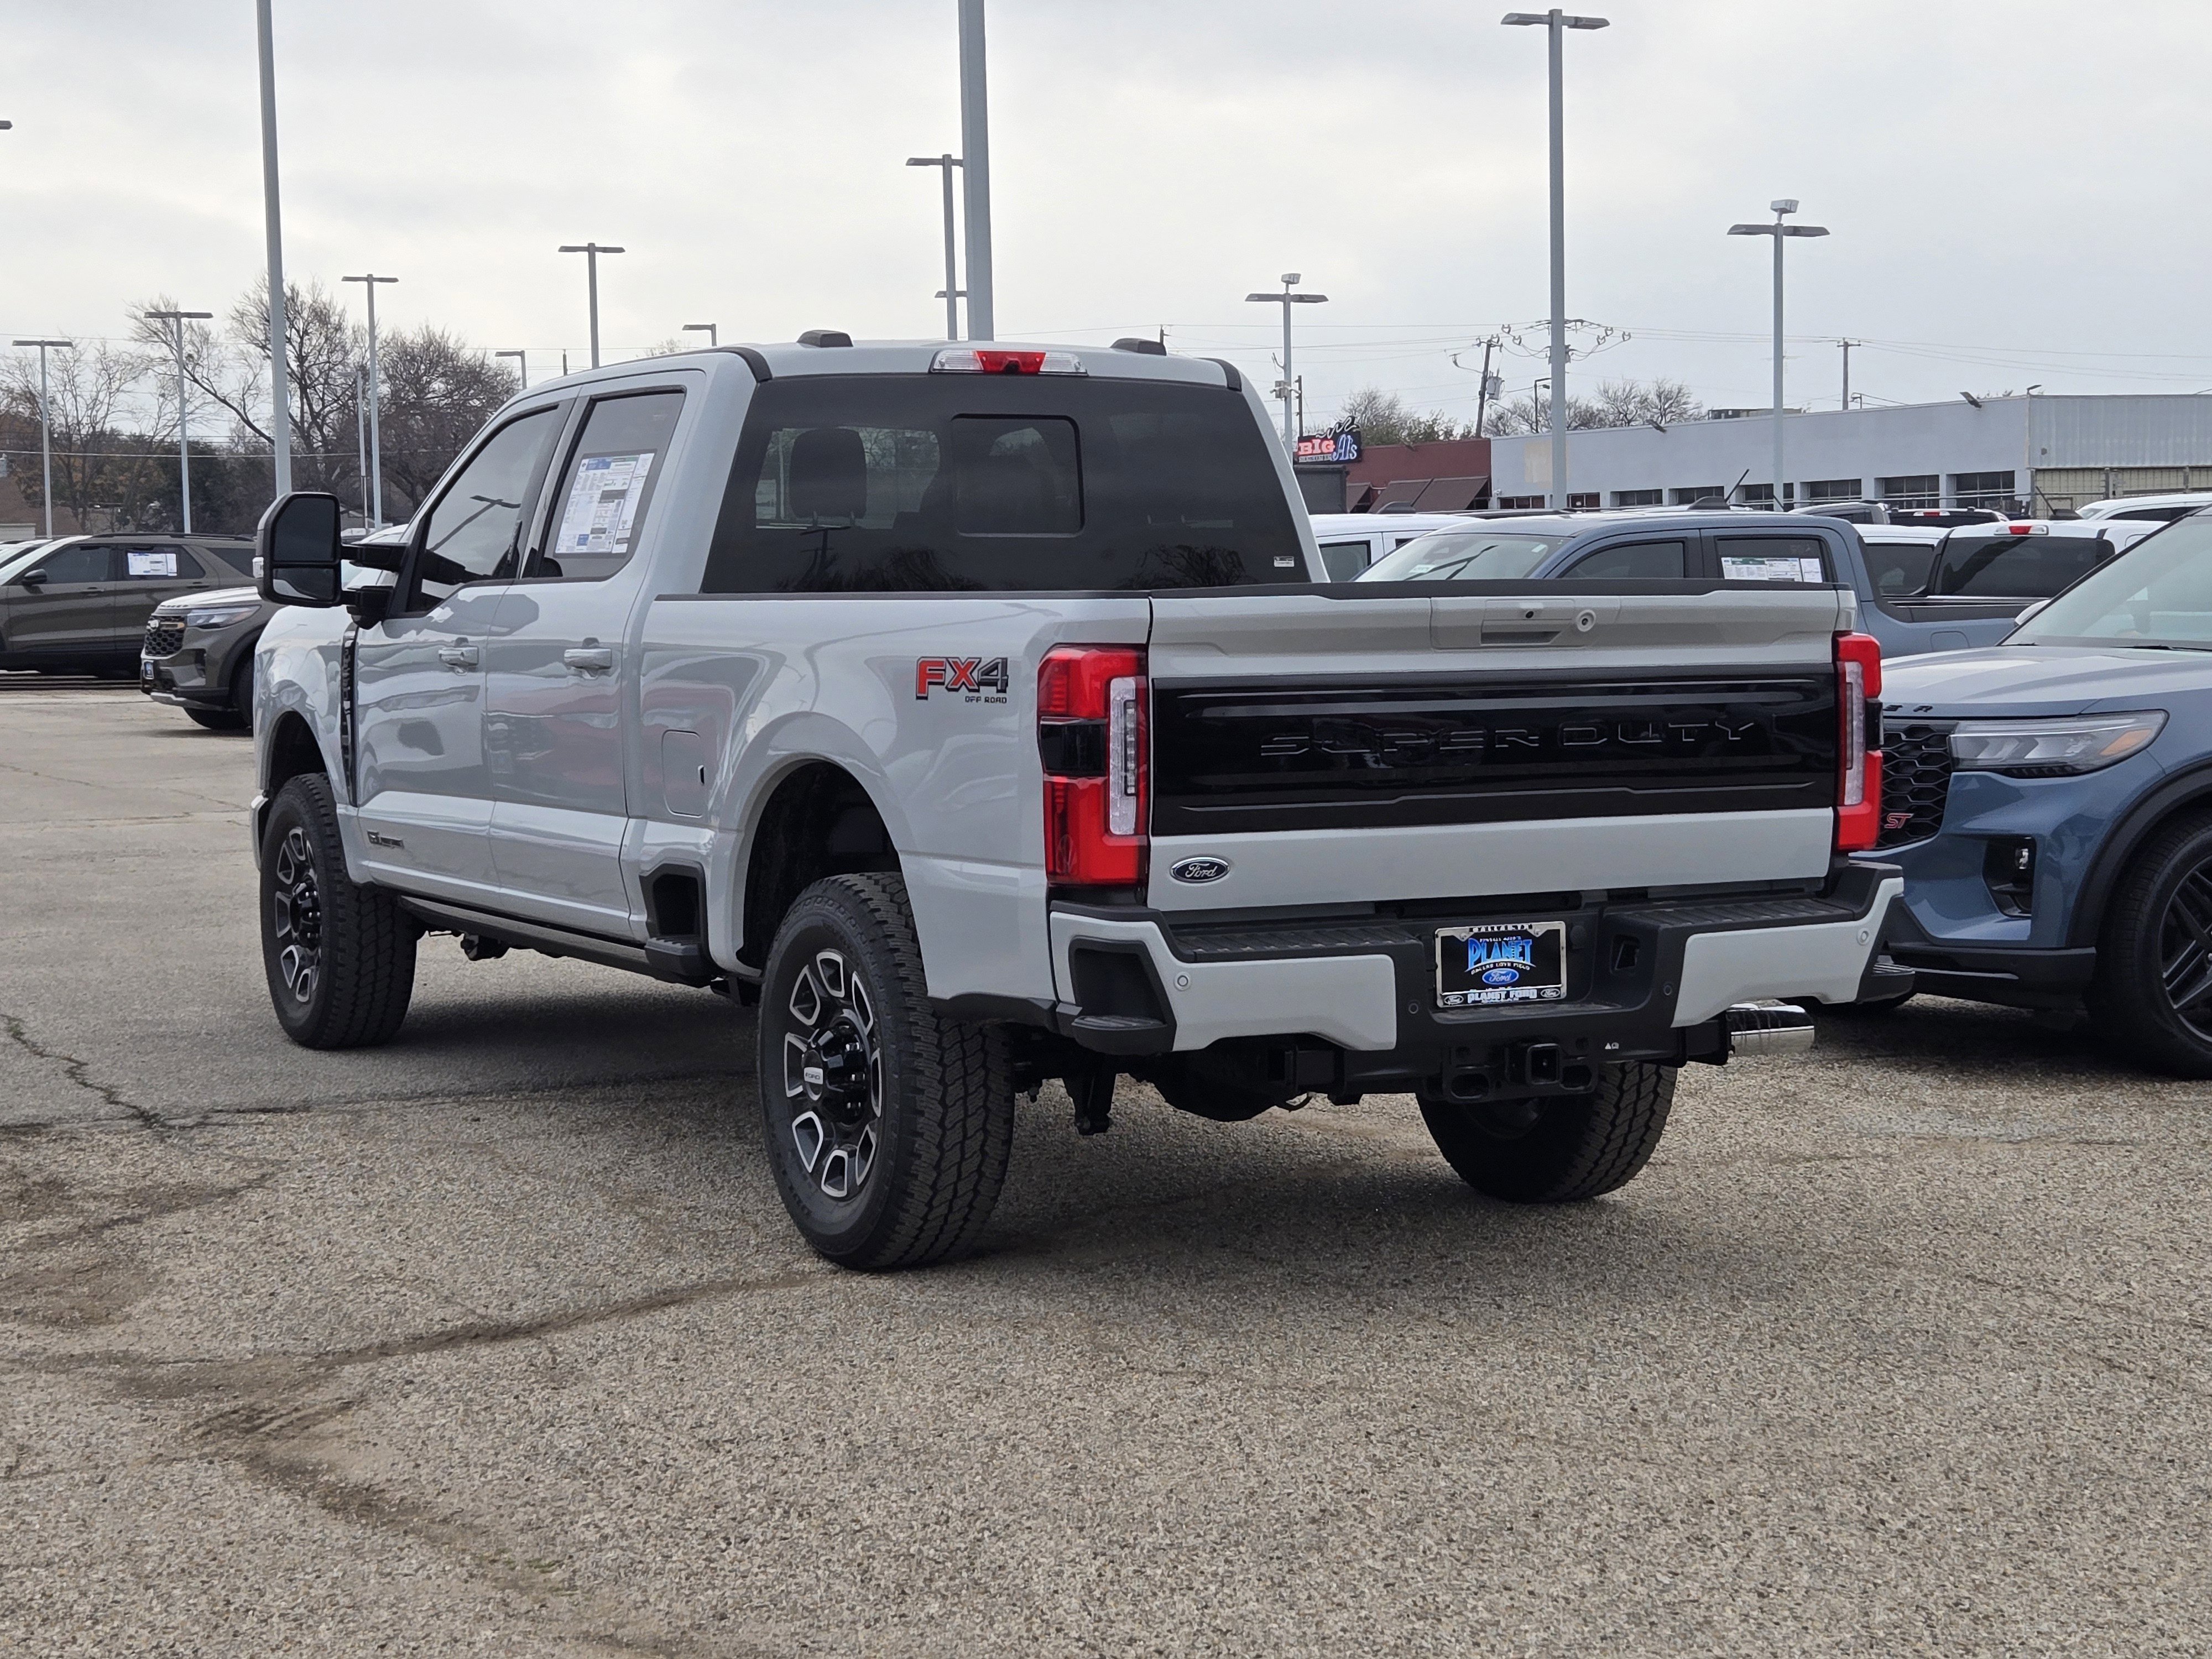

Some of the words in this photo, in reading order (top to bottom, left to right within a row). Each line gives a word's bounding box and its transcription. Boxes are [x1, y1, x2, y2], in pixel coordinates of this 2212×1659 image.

[1298, 439, 1335, 455] BIG
[916, 656, 1009, 700] FX4
[1260, 728, 1540, 756] SUPER
[1559, 721, 1755, 746] DUTY
[1884, 812, 1914, 828] ST
[1185, 863, 1218, 878] Ford
[1468, 937, 1532, 969] PLANET
[1489, 971, 1512, 982] Ford
